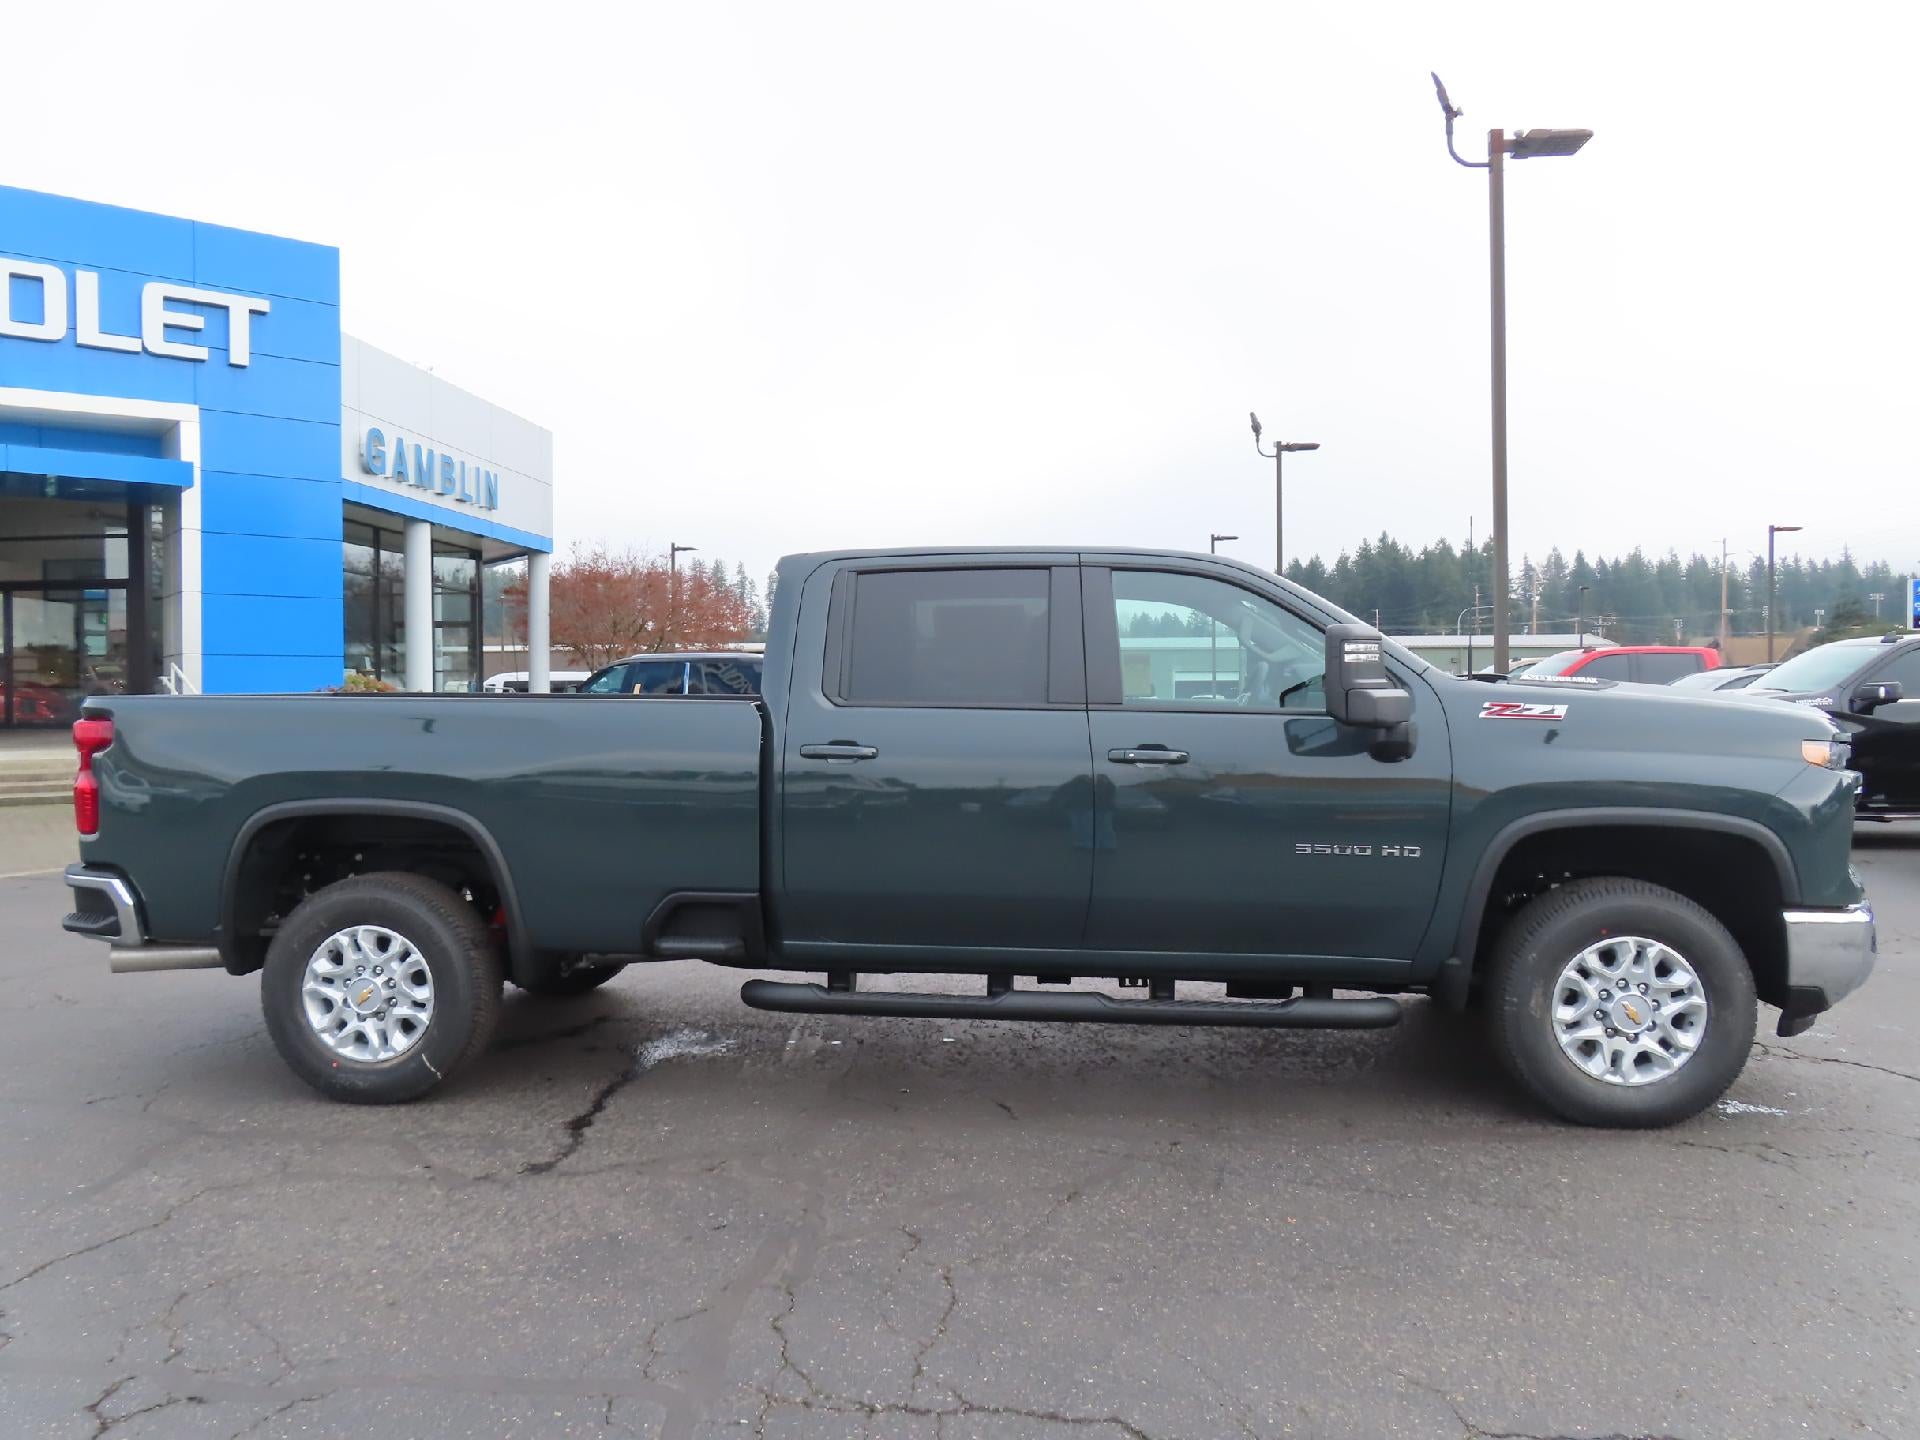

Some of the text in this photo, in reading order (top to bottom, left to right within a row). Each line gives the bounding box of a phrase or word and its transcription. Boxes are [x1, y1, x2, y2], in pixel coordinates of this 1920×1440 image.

[364, 427, 498, 510] GAMBLIN
[1479, 702, 1568, 720] Z71
[1295, 843, 1421, 857] 3500 HD
